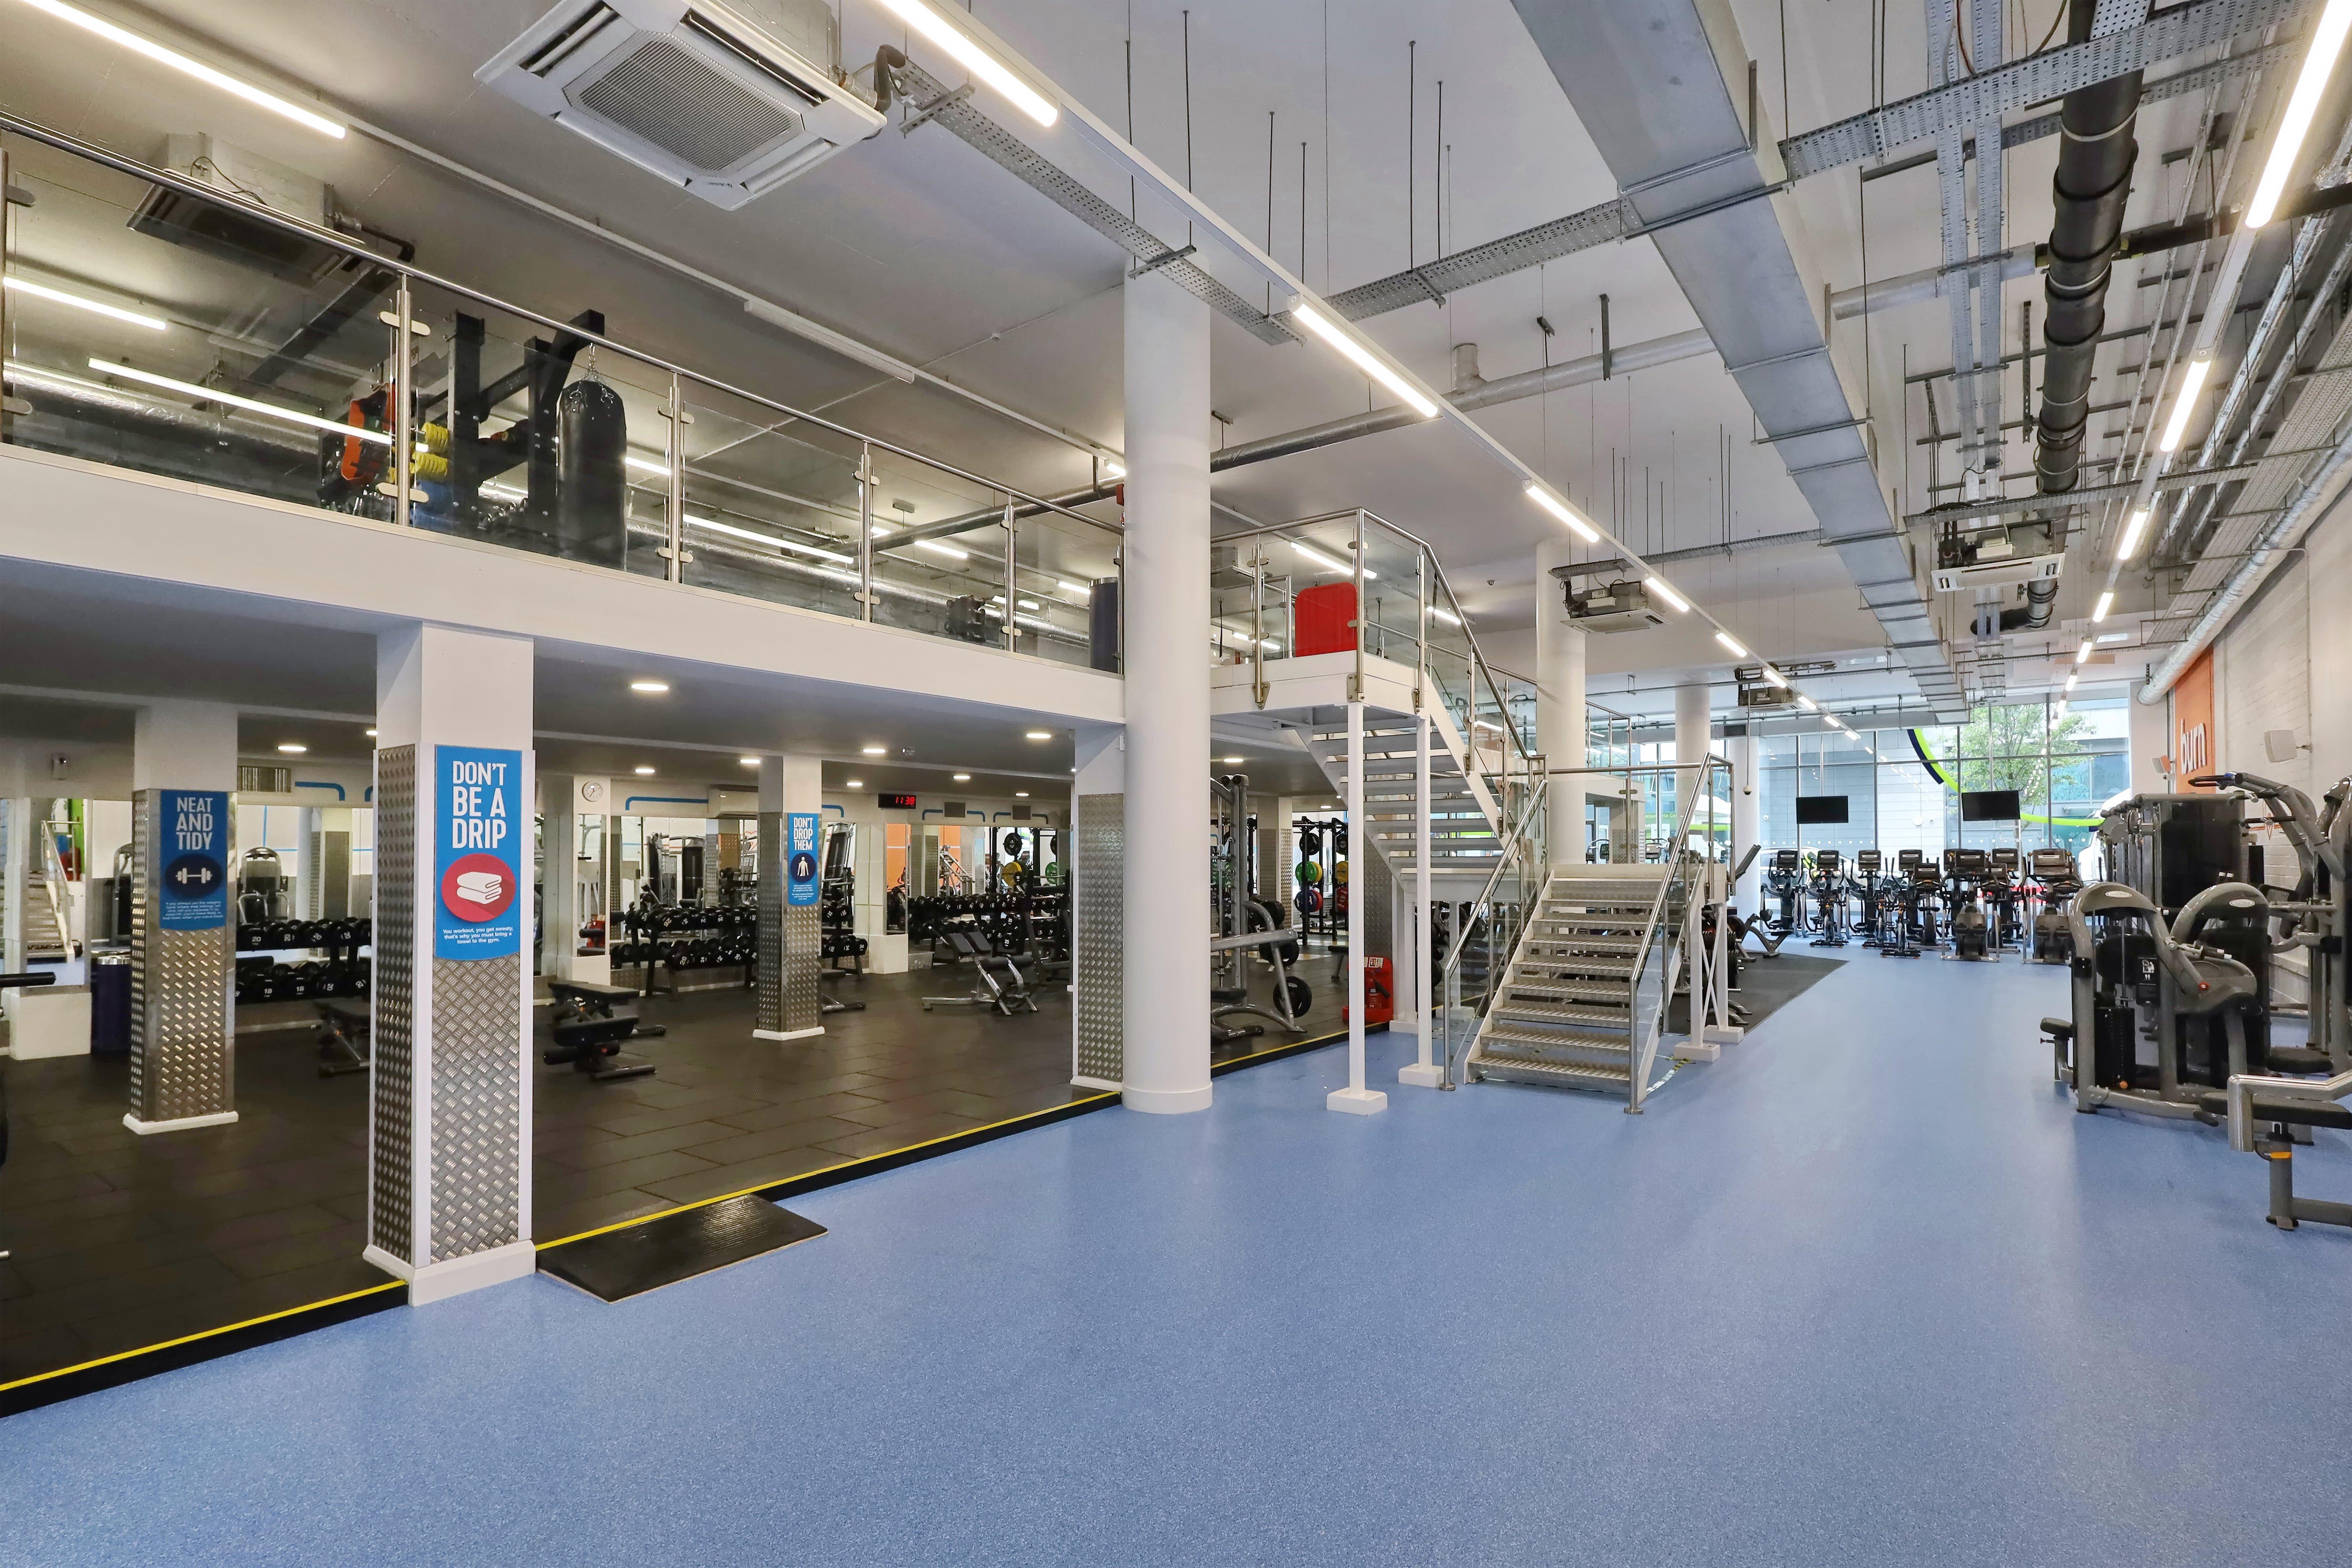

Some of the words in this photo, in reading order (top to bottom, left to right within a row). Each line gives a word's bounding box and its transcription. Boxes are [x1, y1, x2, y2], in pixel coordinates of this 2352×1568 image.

[2181, 719, 2207, 775] burn
[452, 760, 507, 786] DON'T
[176, 797, 213, 812] NEAT
[453, 786, 482, 817] BE
[490, 788, 506, 817] A
[176, 813, 213, 831] AND
[793, 817, 813, 828] DON'T
[176, 832, 213, 850] TIDY
[452, 819, 507, 848] DRIP
[793, 828, 813, 840] DROP
[793, 840, 813, 851] THEM
